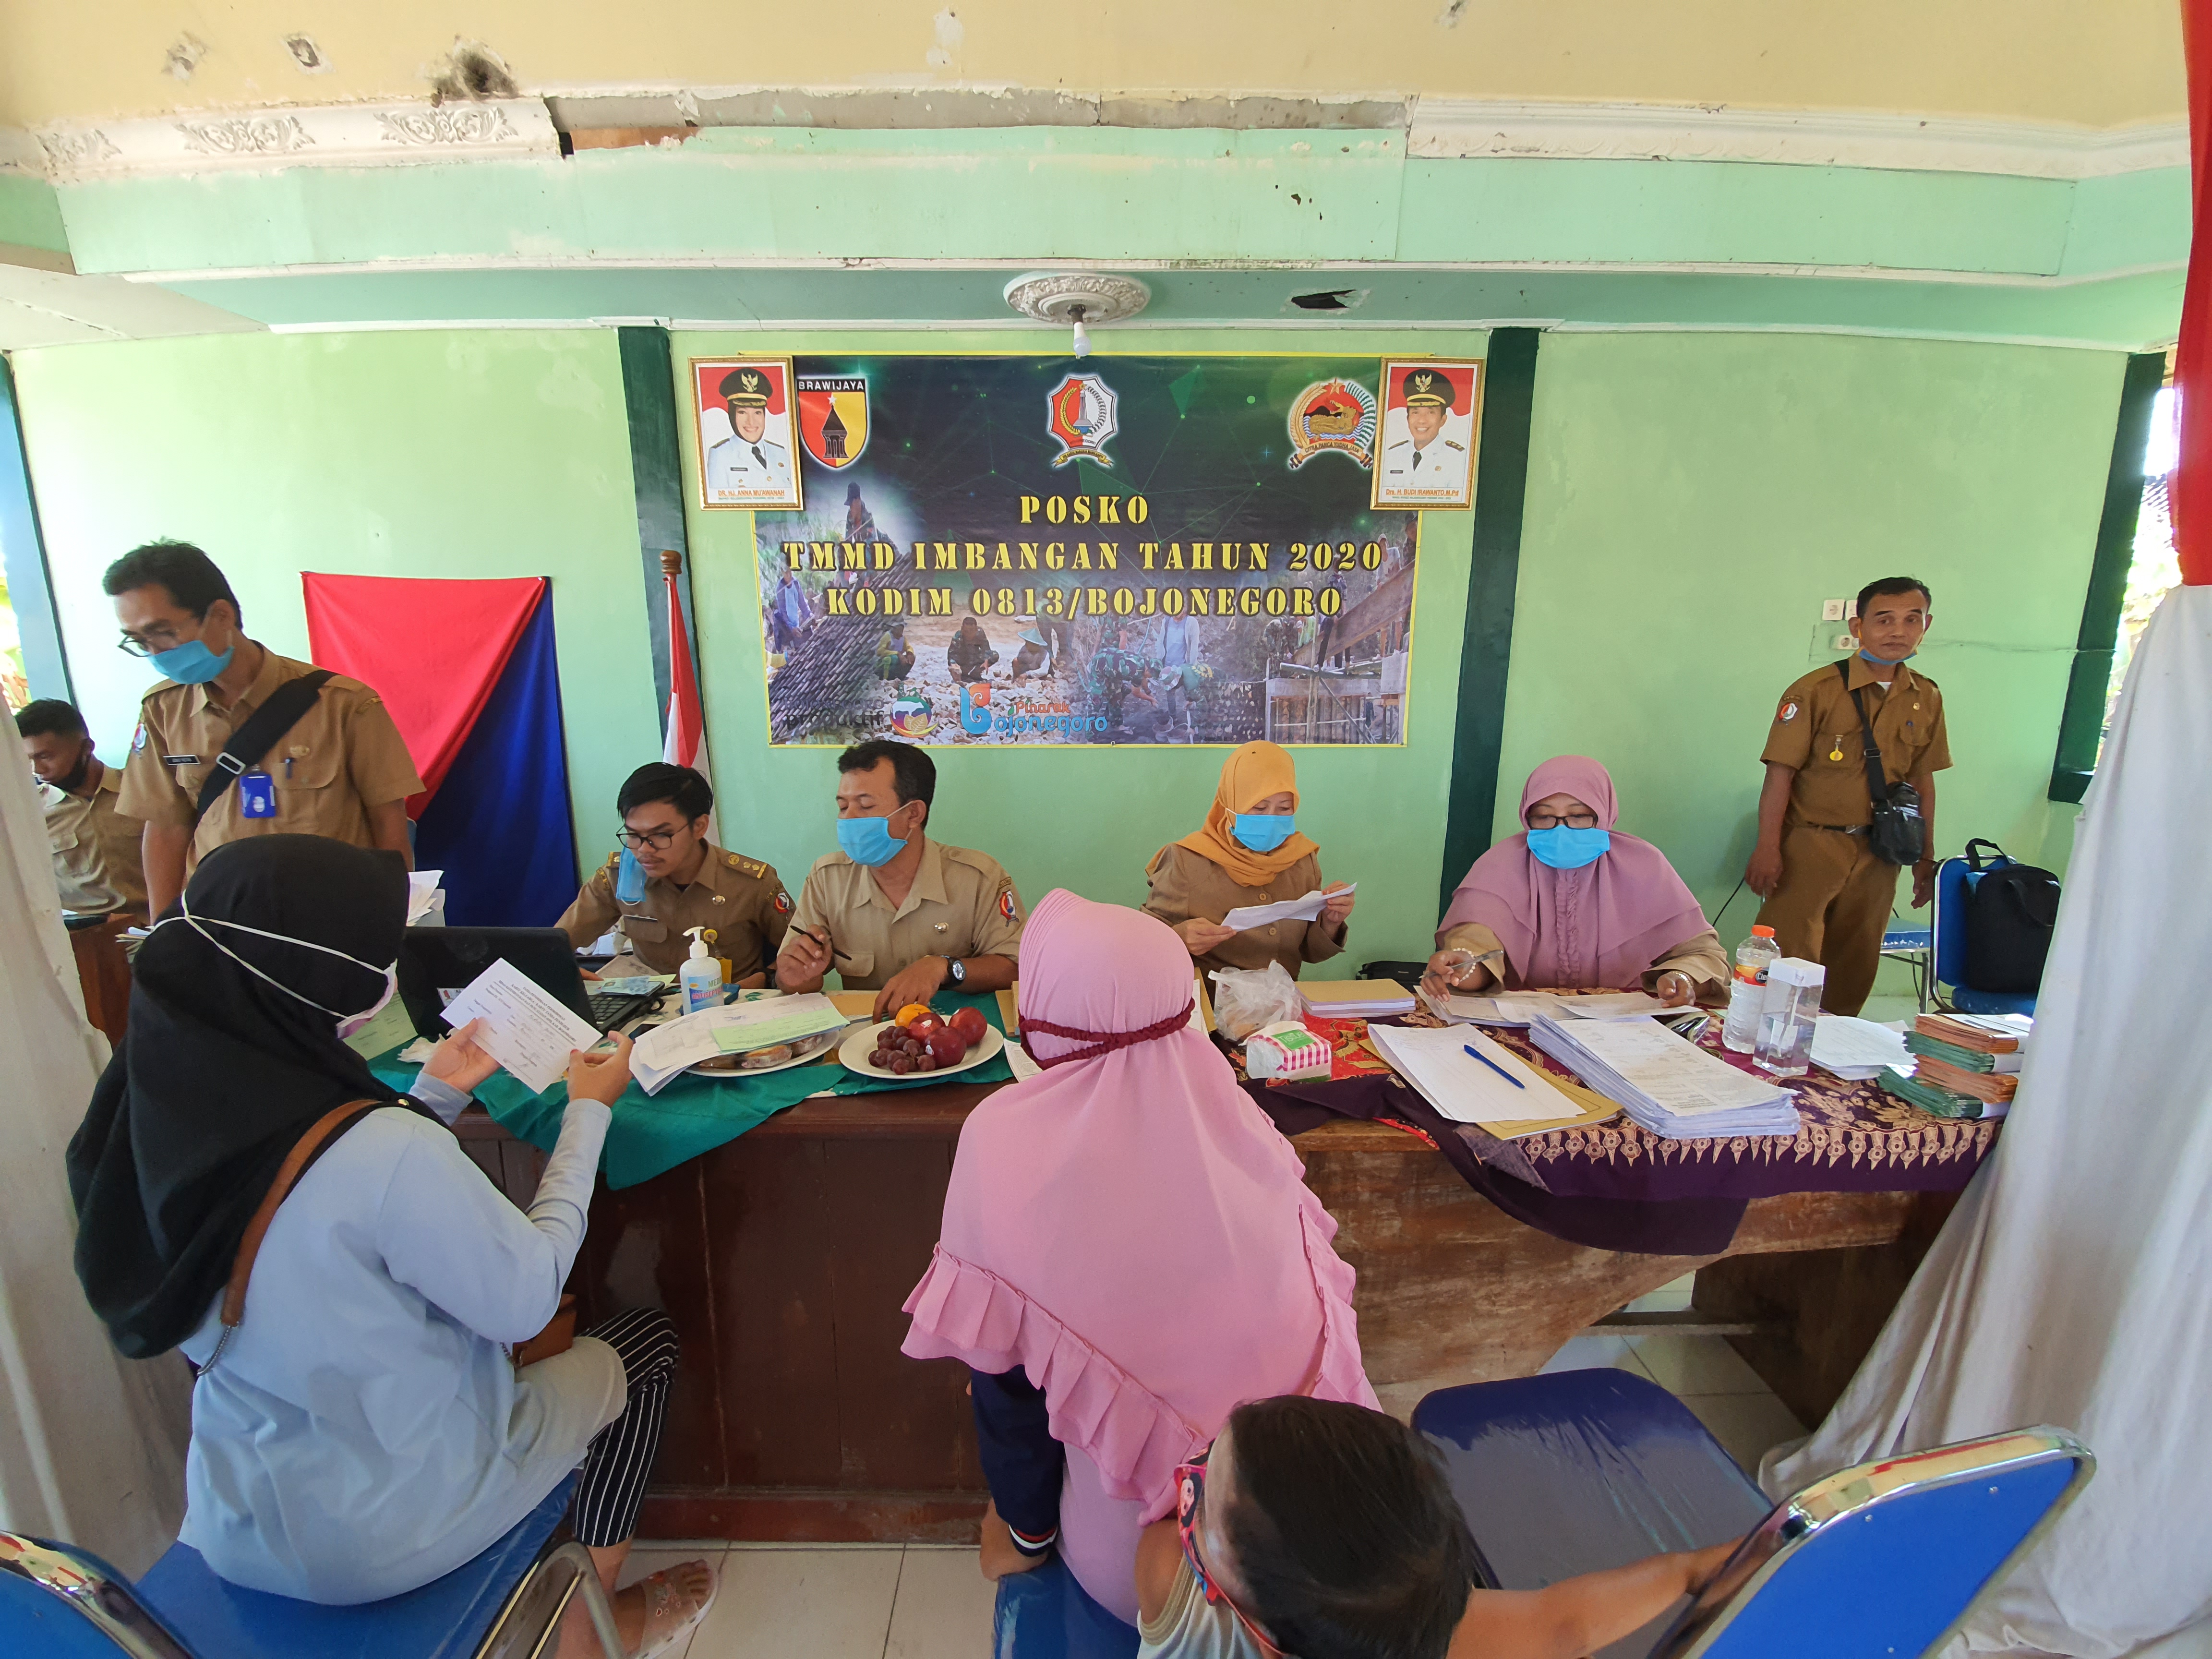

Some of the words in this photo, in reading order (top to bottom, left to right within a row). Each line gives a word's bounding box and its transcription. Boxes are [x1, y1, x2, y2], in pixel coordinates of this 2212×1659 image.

[798, 381, 864, 390] BRAWIJAYA
[1305, 445, 1318, 453] CITRA
[1349, 445, 1359, 453] JAYA
[1020, 495, 1149, 524] POSKO
[783, 541, 895, 570] TMMD
[915, 542, 1120, 570] IMBANGAN
[1139, 542, 1271, 570] TAHUN
[1290, 541, 1383, 571] 2020
[827, 588, 953, 616] KODIM
[973, 588, 1342, 621] 0813/BOJONEGORO
[1015, 700, 1071, 714] Pinarak
[1757, 972, 1767, 980] Cle
